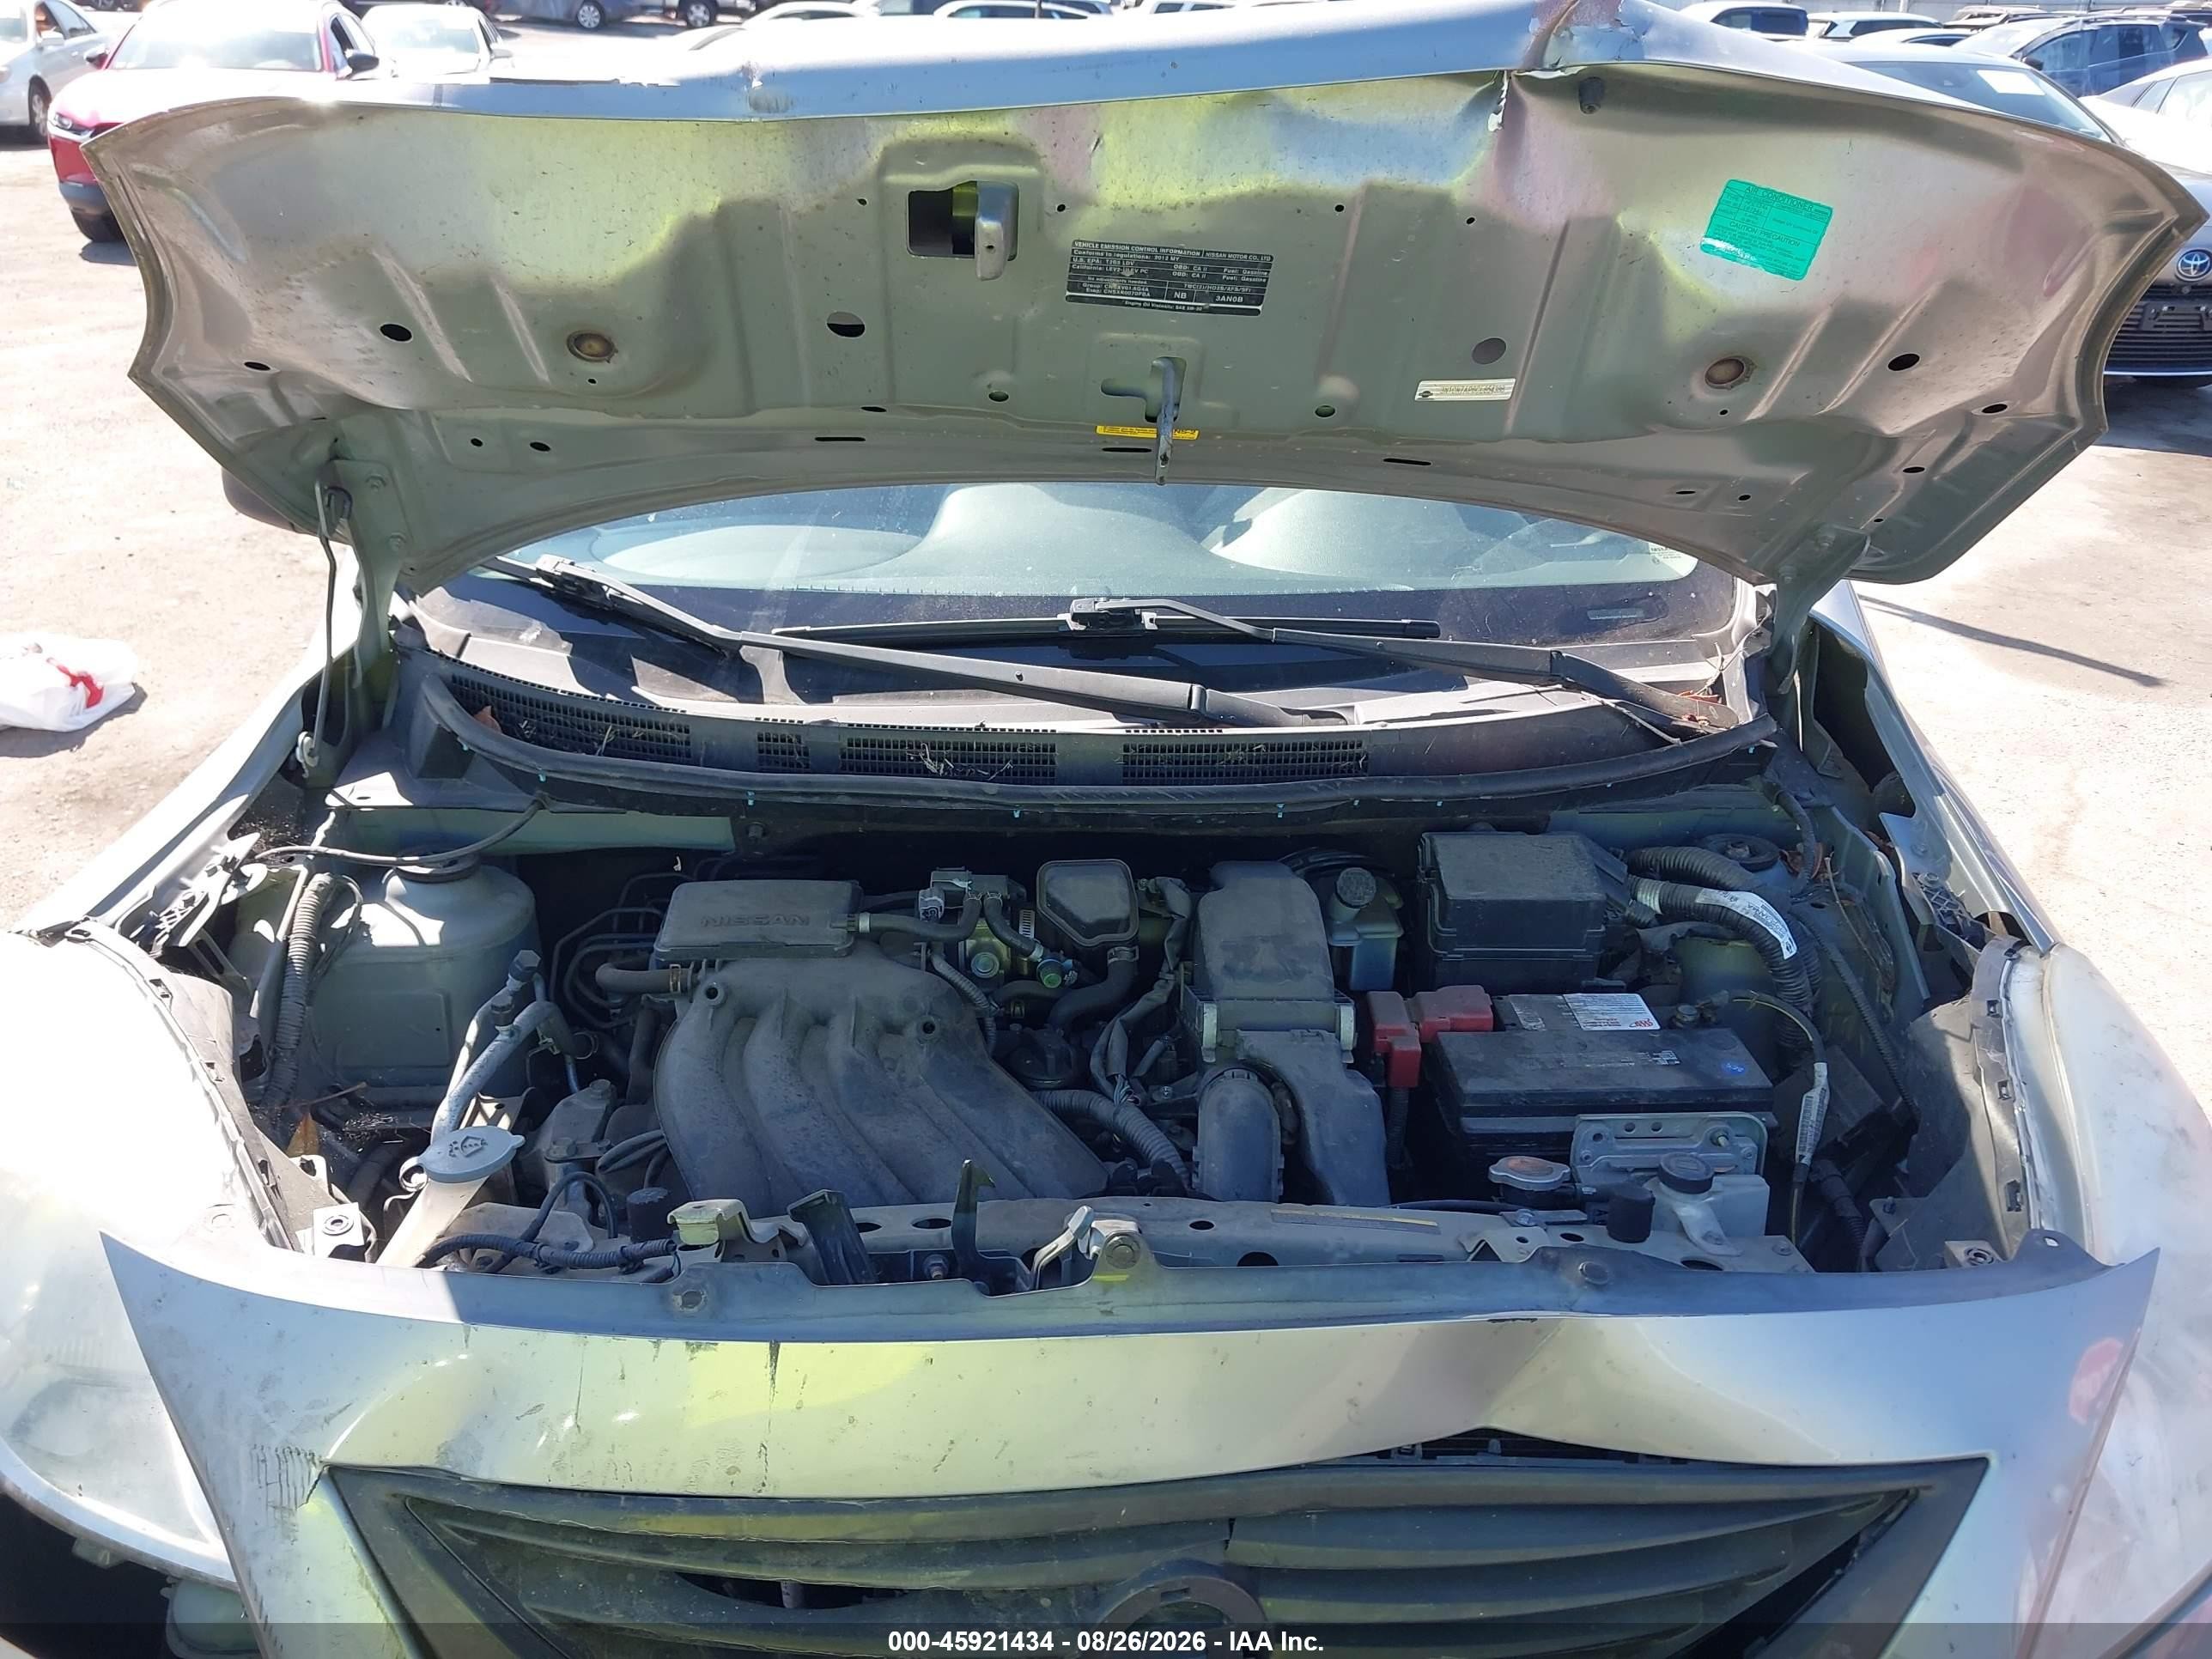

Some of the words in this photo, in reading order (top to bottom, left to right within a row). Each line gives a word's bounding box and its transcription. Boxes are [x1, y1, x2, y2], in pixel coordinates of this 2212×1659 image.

[1744, 185, 1759, 196] AIR
[1760, 190, 1814, 211] CONDITIONER
[1729, 221, 1758, 234] CAUTION
[1759, 229, 1801, 247] PRECAUTION
[701, 913, 810, 927] NISSAN
